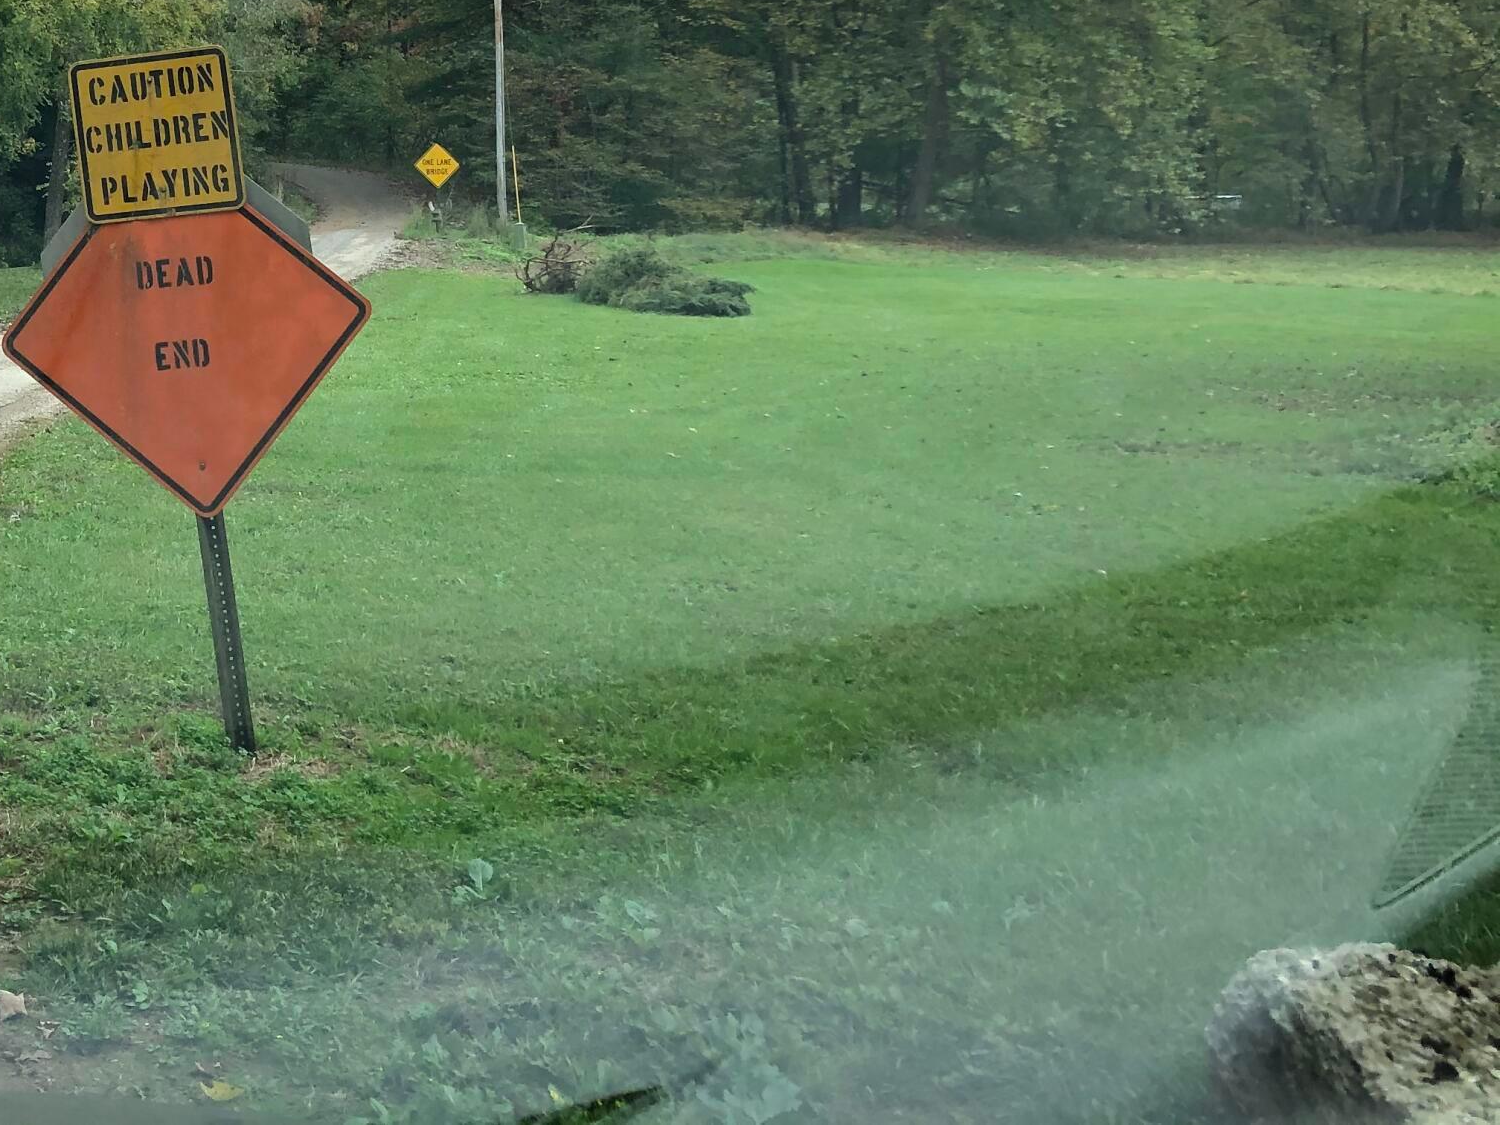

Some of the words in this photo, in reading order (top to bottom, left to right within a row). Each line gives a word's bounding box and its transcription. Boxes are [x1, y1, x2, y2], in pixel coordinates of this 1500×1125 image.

[88, 63, 215, 106] CAUTION
[86, 110, 230, 154] CHILDREN
[101, 163, 230, 206] PLAYING
[135, 255, 214, 290] DEAD
[154, 338, 211, 371] END
